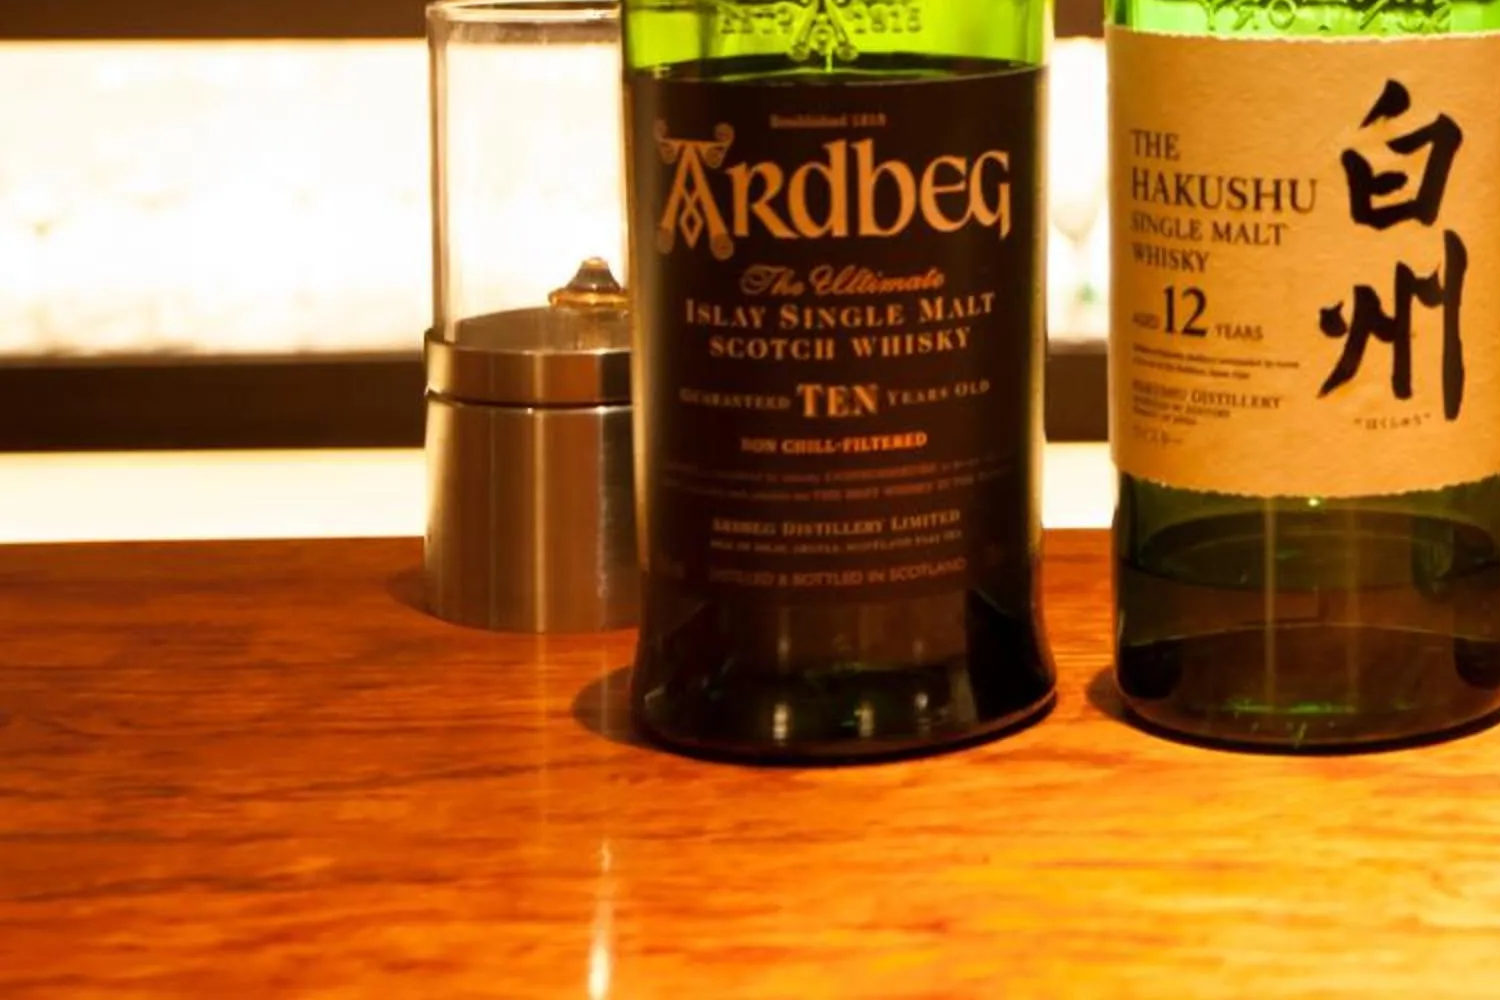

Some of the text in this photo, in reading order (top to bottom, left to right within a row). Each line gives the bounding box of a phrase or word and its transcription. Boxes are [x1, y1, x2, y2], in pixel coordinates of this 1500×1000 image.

[1131, 128, 1180, 161] THE
[1131, 166, 1318, 214] HAKUSHU
[1131, 210, 1289, 247] SINGLE MALT
[1131, 241, 1210, 273] WHISKY
[1318, 78, 1467, 421] 白州
[740, 264, 945, 297] The Ultimate
[685, 291, 997, 330] ISLAY SINGLE MALT
[1163, 284, 1209, 338] 12
[1215, 322, 1264, 341] YEARS
[709, 326, 972, 361] SCOTCH WHISKY
[796, 383, 879, 419] TEN
[886, 386, 949, 408] YEARS
[953, 379, 991, 398] OLD
[1191, 388, 1281, 409] DISTILLERY
[891, 508, 962, 532] LIMITED
